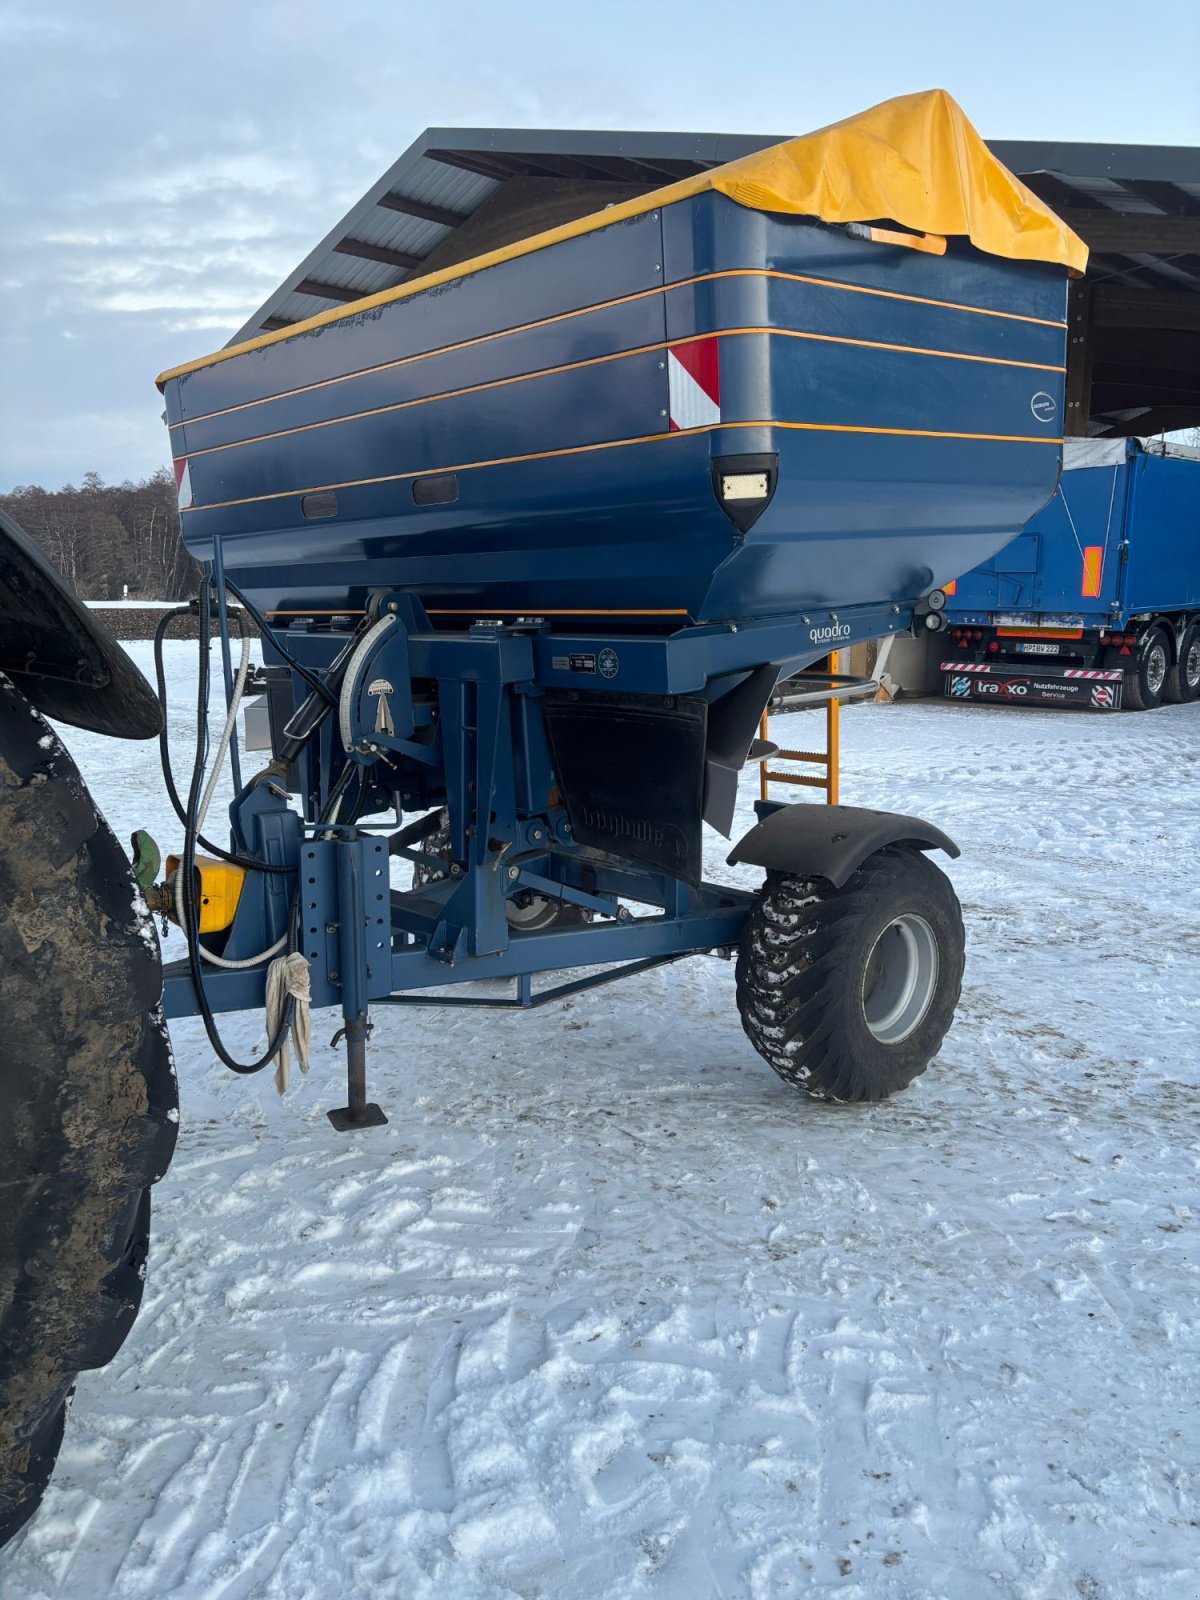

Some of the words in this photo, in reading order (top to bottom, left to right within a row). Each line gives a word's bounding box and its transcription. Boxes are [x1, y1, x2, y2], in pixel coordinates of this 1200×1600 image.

[810, 621, 850, 644] quadro
[1034, 683, 1078, 692] Nutzfahrzeuge
[1042, 691, 1065, 699] Service
